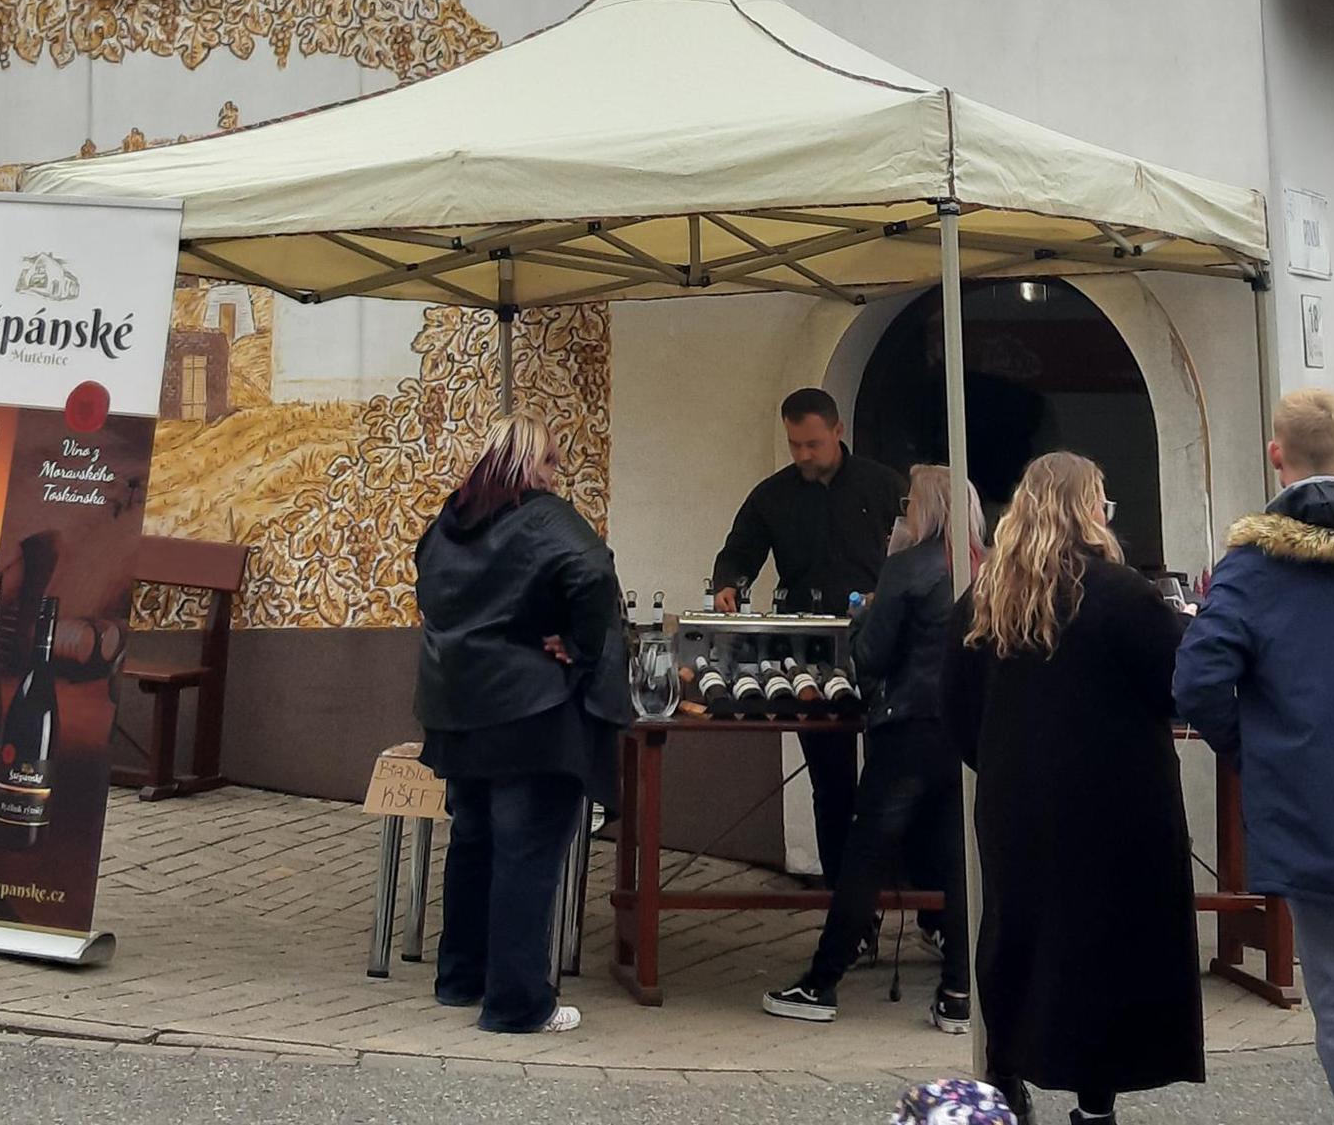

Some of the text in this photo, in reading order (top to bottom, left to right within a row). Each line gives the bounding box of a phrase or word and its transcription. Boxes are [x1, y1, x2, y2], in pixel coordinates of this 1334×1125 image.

[91, 448, 100, 462] z
[38, 460, 115, 482] Moravského
[43, 484, 107, 505] Toskánska
